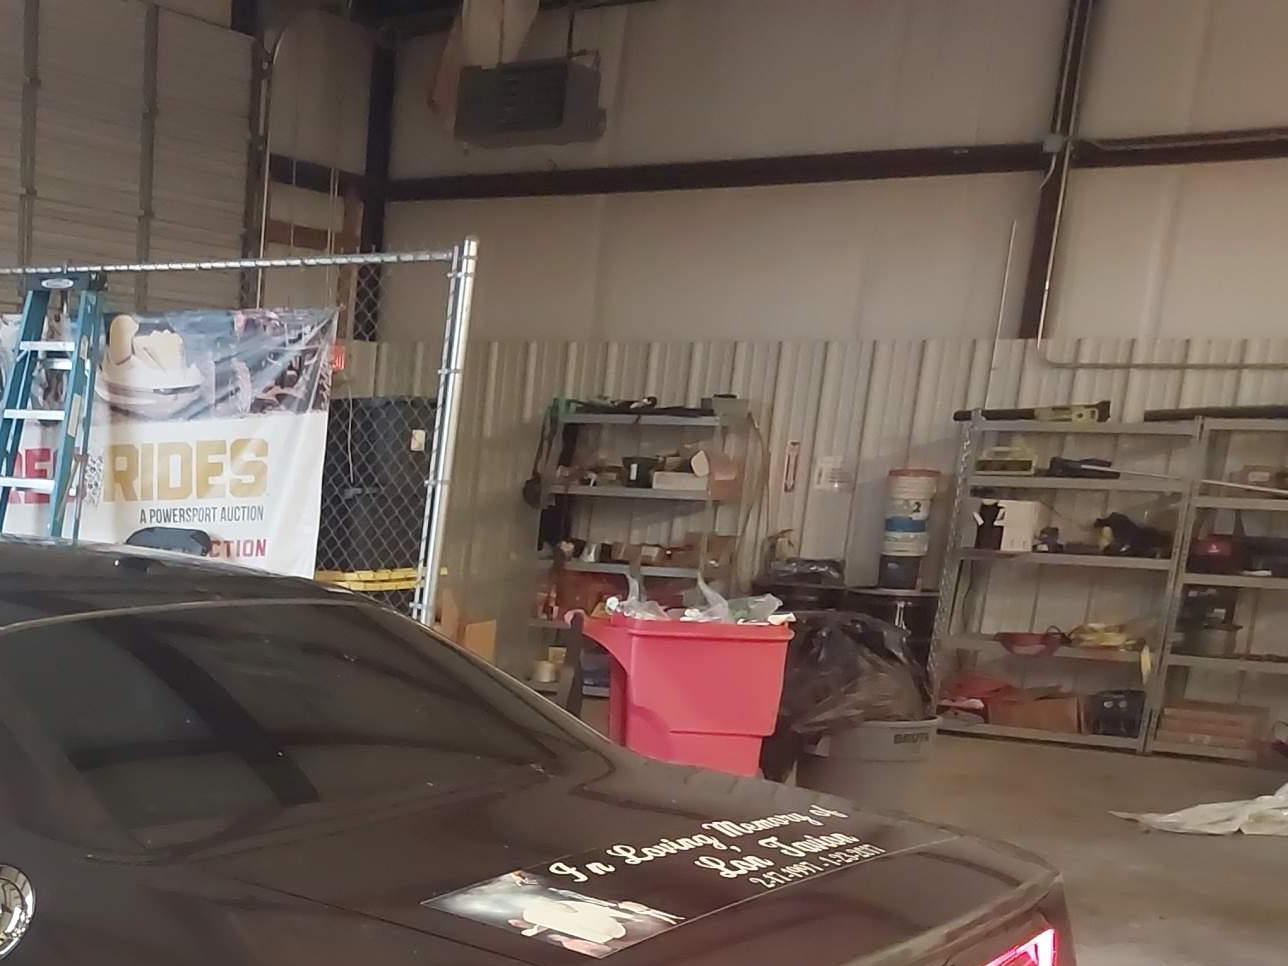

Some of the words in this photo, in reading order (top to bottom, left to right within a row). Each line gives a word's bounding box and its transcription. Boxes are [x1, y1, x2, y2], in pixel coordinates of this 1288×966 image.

[103, 438, 268, 502] RIDES
[139, 509, 147, 524] A
[150, 507, 218, 524] POWERSPORT
[221, 505, 264, 522] AUCTION
[209, 539, 267, 558] CTION
[548, 862, 616, 883] In
[605, 833, 728, 865] Loving
[701, 812, 824, 838] Memory
[809, 804, 848, 818] of
